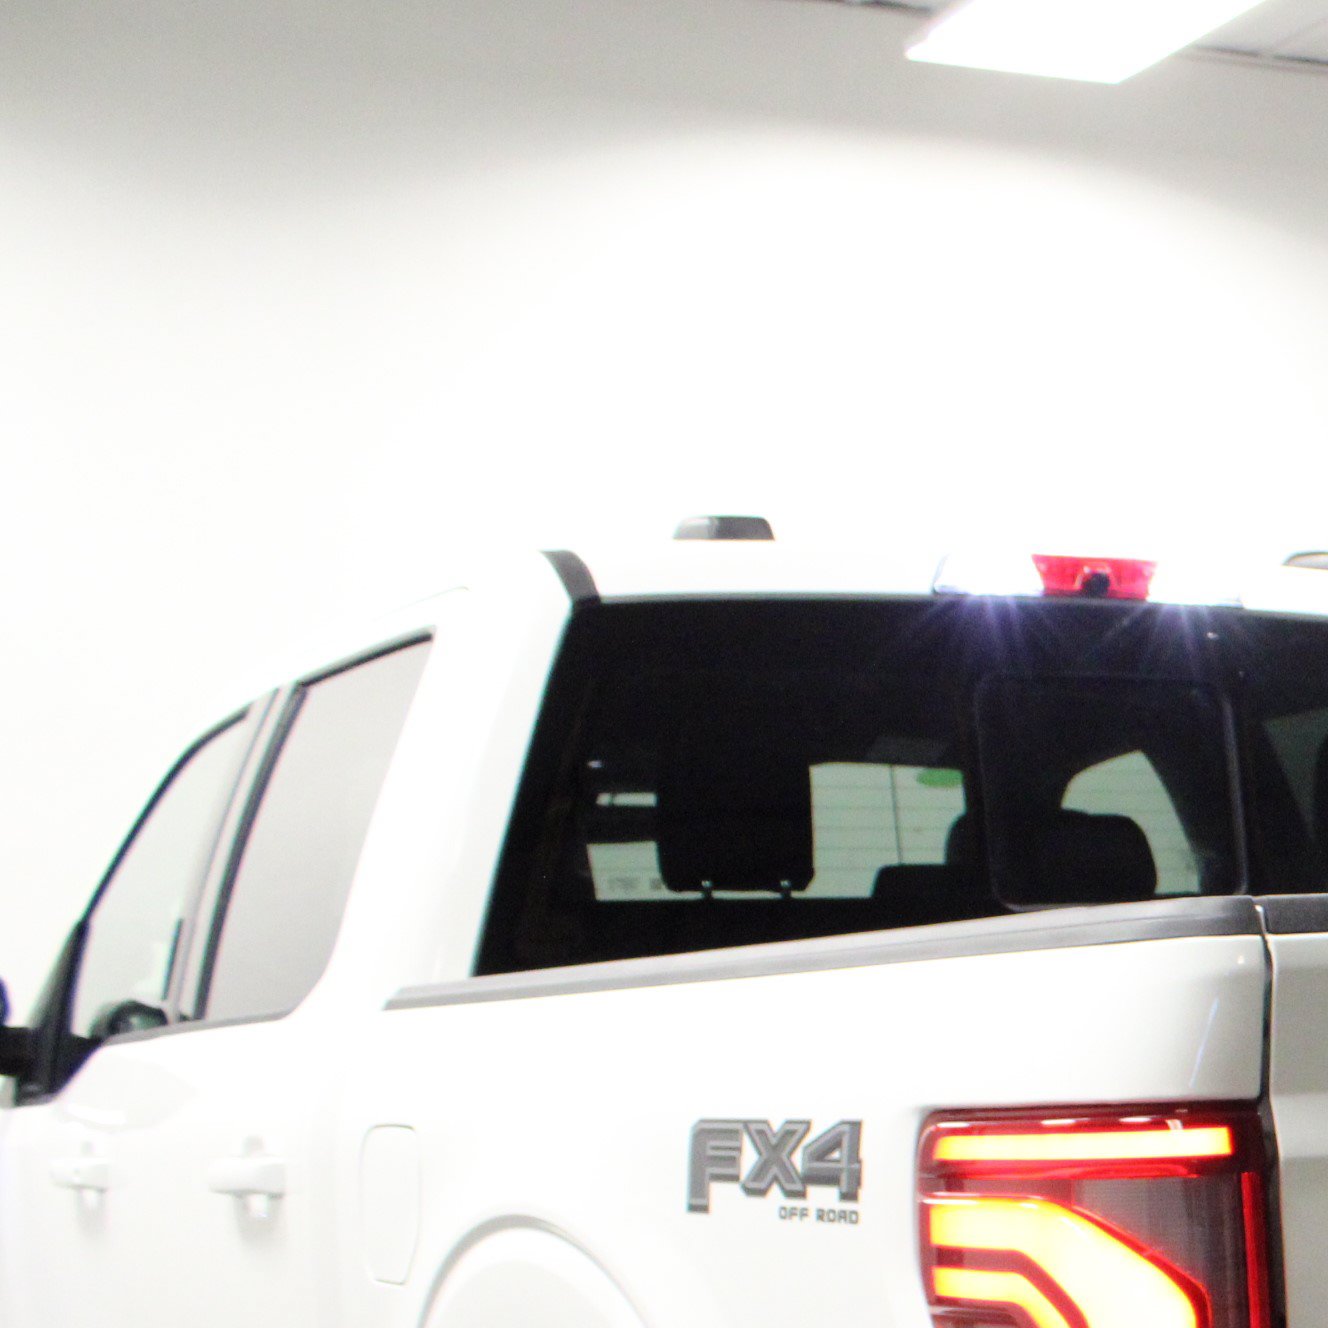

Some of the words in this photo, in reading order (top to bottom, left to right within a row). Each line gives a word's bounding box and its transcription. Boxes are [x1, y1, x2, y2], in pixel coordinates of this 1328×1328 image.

[687, 1119, 862, 1213] FX4
[778, 1206, 809, 1221] OFF
[815, 1208, 860, 1225] ROAD
